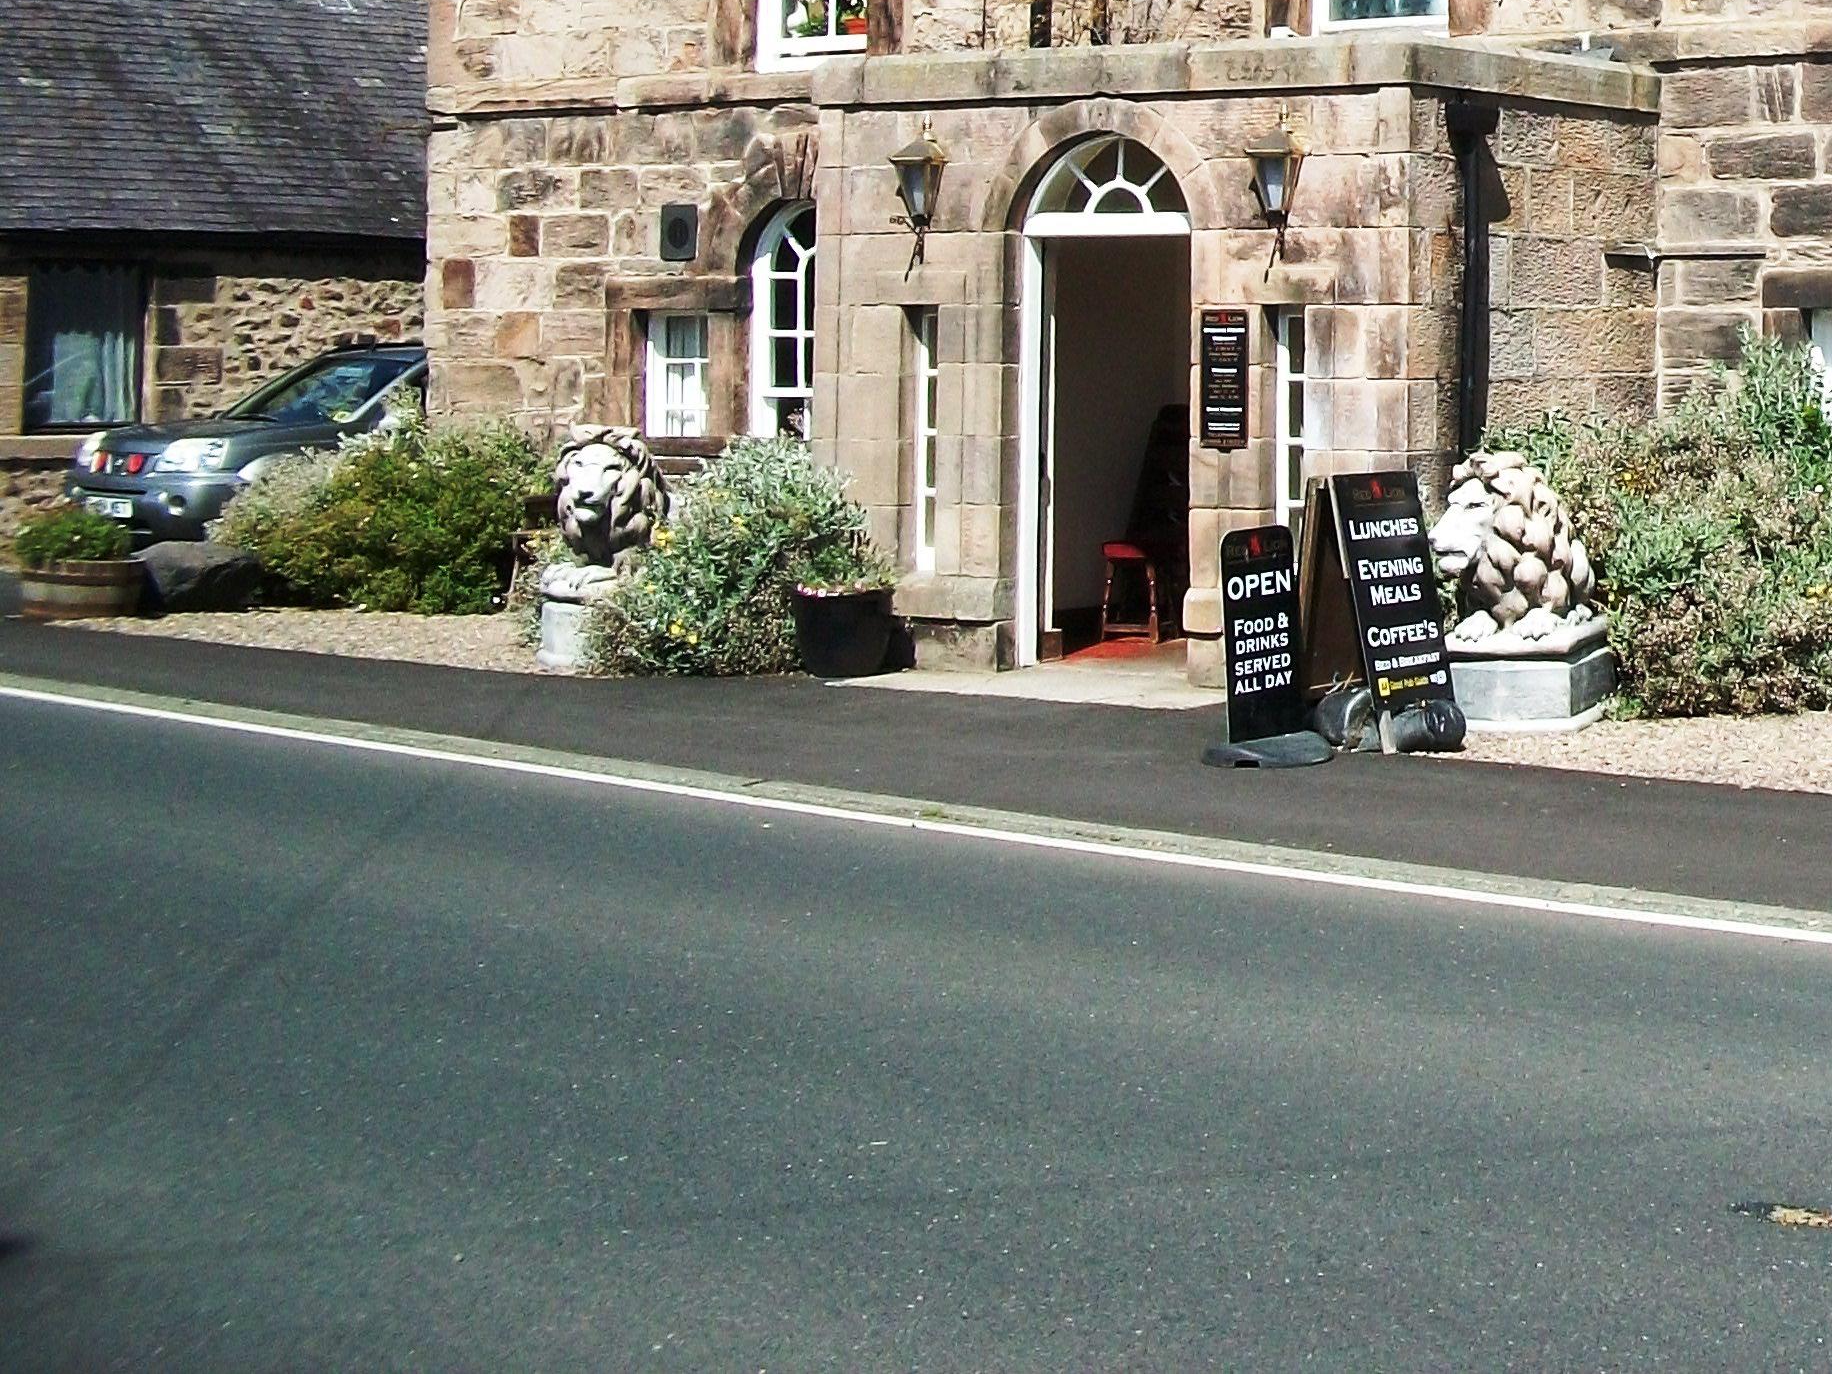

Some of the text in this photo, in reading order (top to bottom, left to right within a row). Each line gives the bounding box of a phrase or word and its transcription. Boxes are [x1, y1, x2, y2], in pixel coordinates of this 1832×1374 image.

[1349, 517, 1419, 541] LUNCHES
[1358, 557, 1424, 580] EVENING
[1227, 570, 1291, 600] OPEN
[1371, 583, 1422, 606] MEALS
[1234, 612, 1289, 636] FOOD &
[1367, 620, 1439, 647] COFFEE'S
[1235, 632, 1289, 655] DRINKS
[1235, 653, 1291, 676] SERVED
[1234, 670, 1294, 695] ALL DAY
